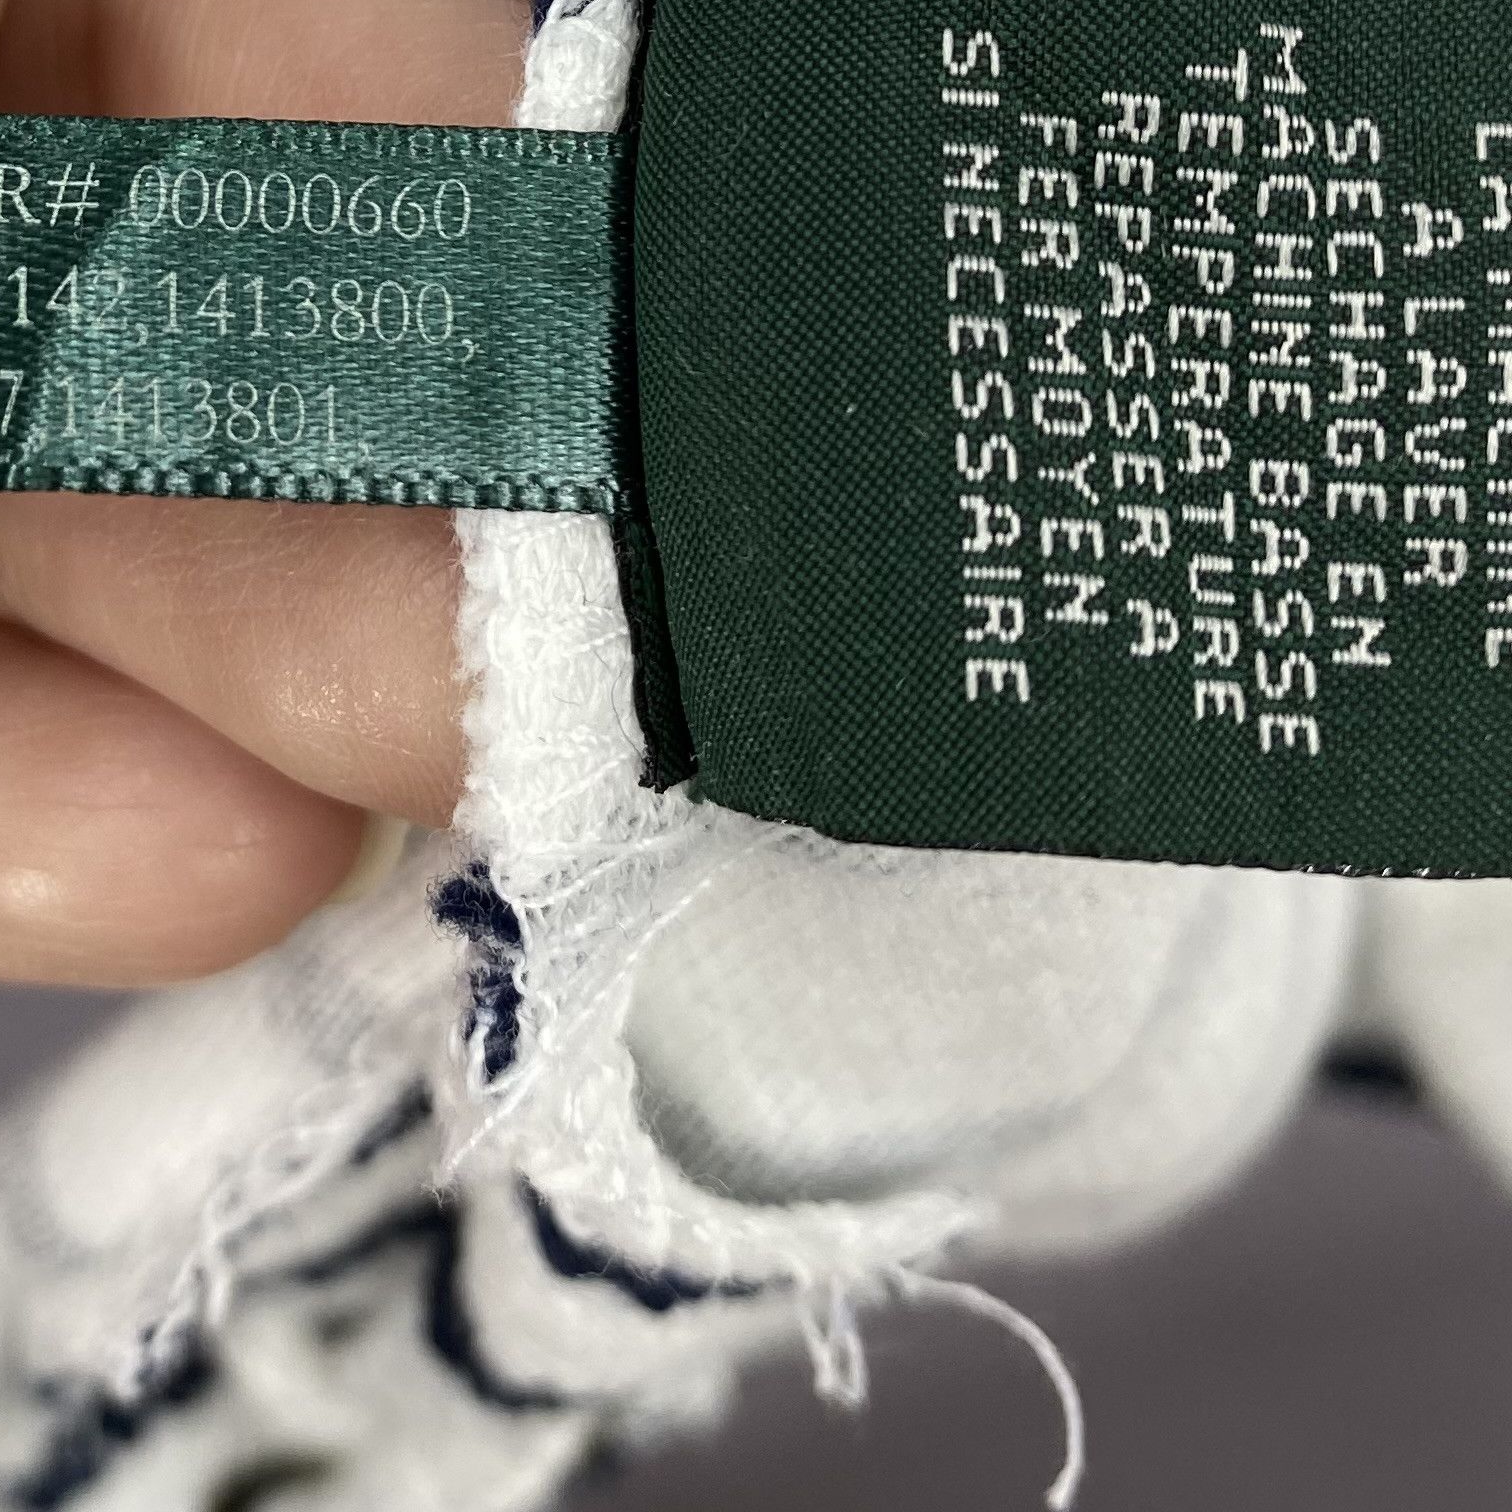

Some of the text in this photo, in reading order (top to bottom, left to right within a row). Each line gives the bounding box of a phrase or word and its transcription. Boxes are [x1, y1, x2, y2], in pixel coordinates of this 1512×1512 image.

[128, 166, 473, 240] 00000660
[942, 28, 1031, 702] SI NECESSAIRE
[1018, 113, 1111, 627] FER MOYEN
[1093, 91, 1180, 657] REPASSER A
[1169, 48, 1250, 724] TEMPERATURE
[1249, 23, 1320, 755] MACHINE BASSE
[1325, 118, 1392, 667] SECHAGE EN
[1401, 202, 1468, 587] A LAVER
